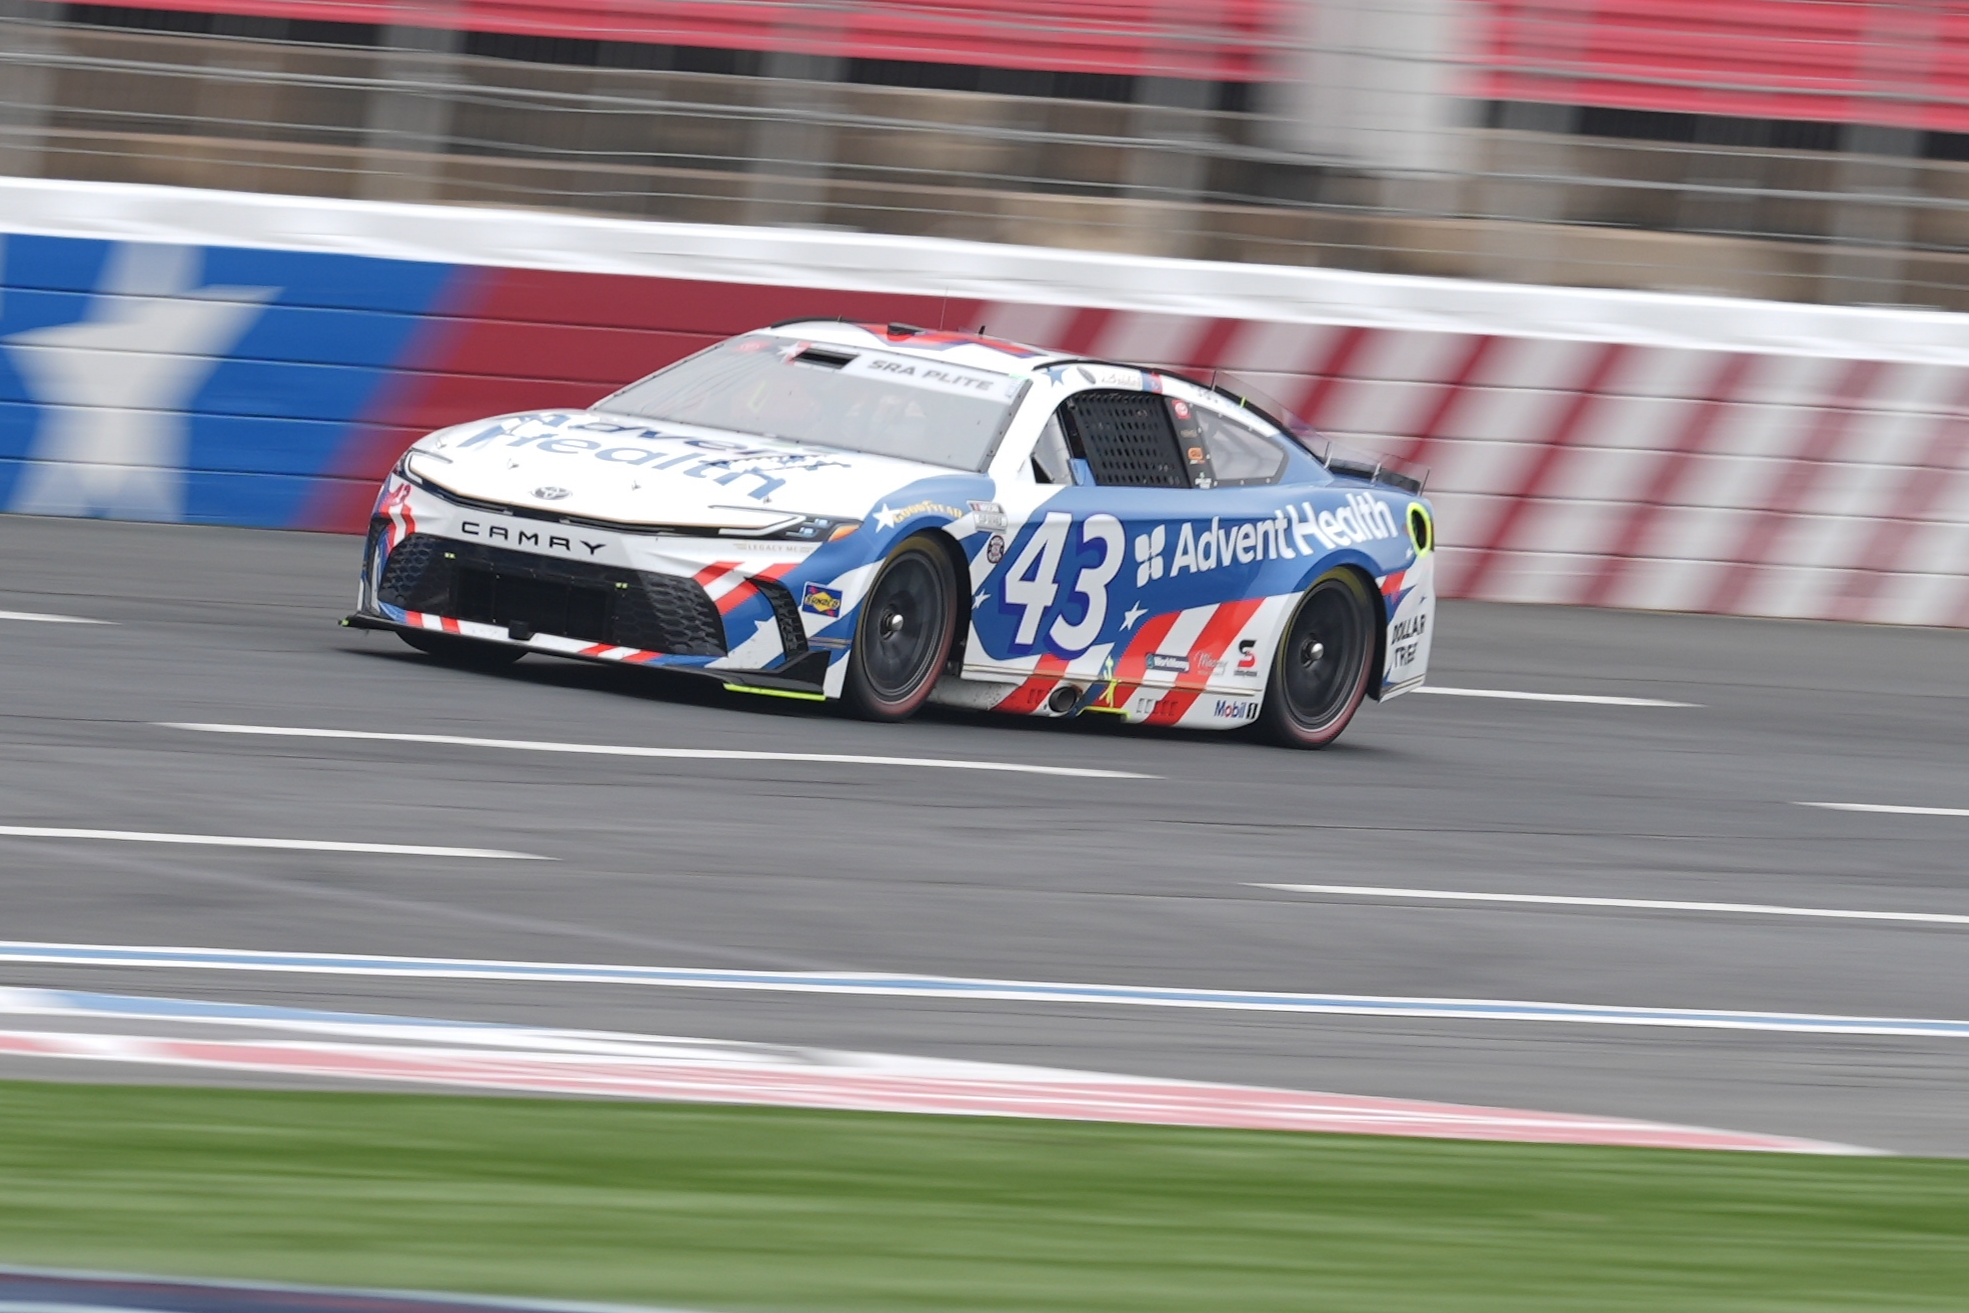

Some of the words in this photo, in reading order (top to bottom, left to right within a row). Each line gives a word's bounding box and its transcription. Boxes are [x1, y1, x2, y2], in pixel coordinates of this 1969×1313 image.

[867, 359, 916, 376] SRA
[921, 369, 994, 392] PLITE
[461, 521, 606, 555] CAMRY
[1169, 492, 1399, 578] AdventHealth
[1002, 511, 1126, 654] 43
[1214, 700, 1245, 719] Mobil
